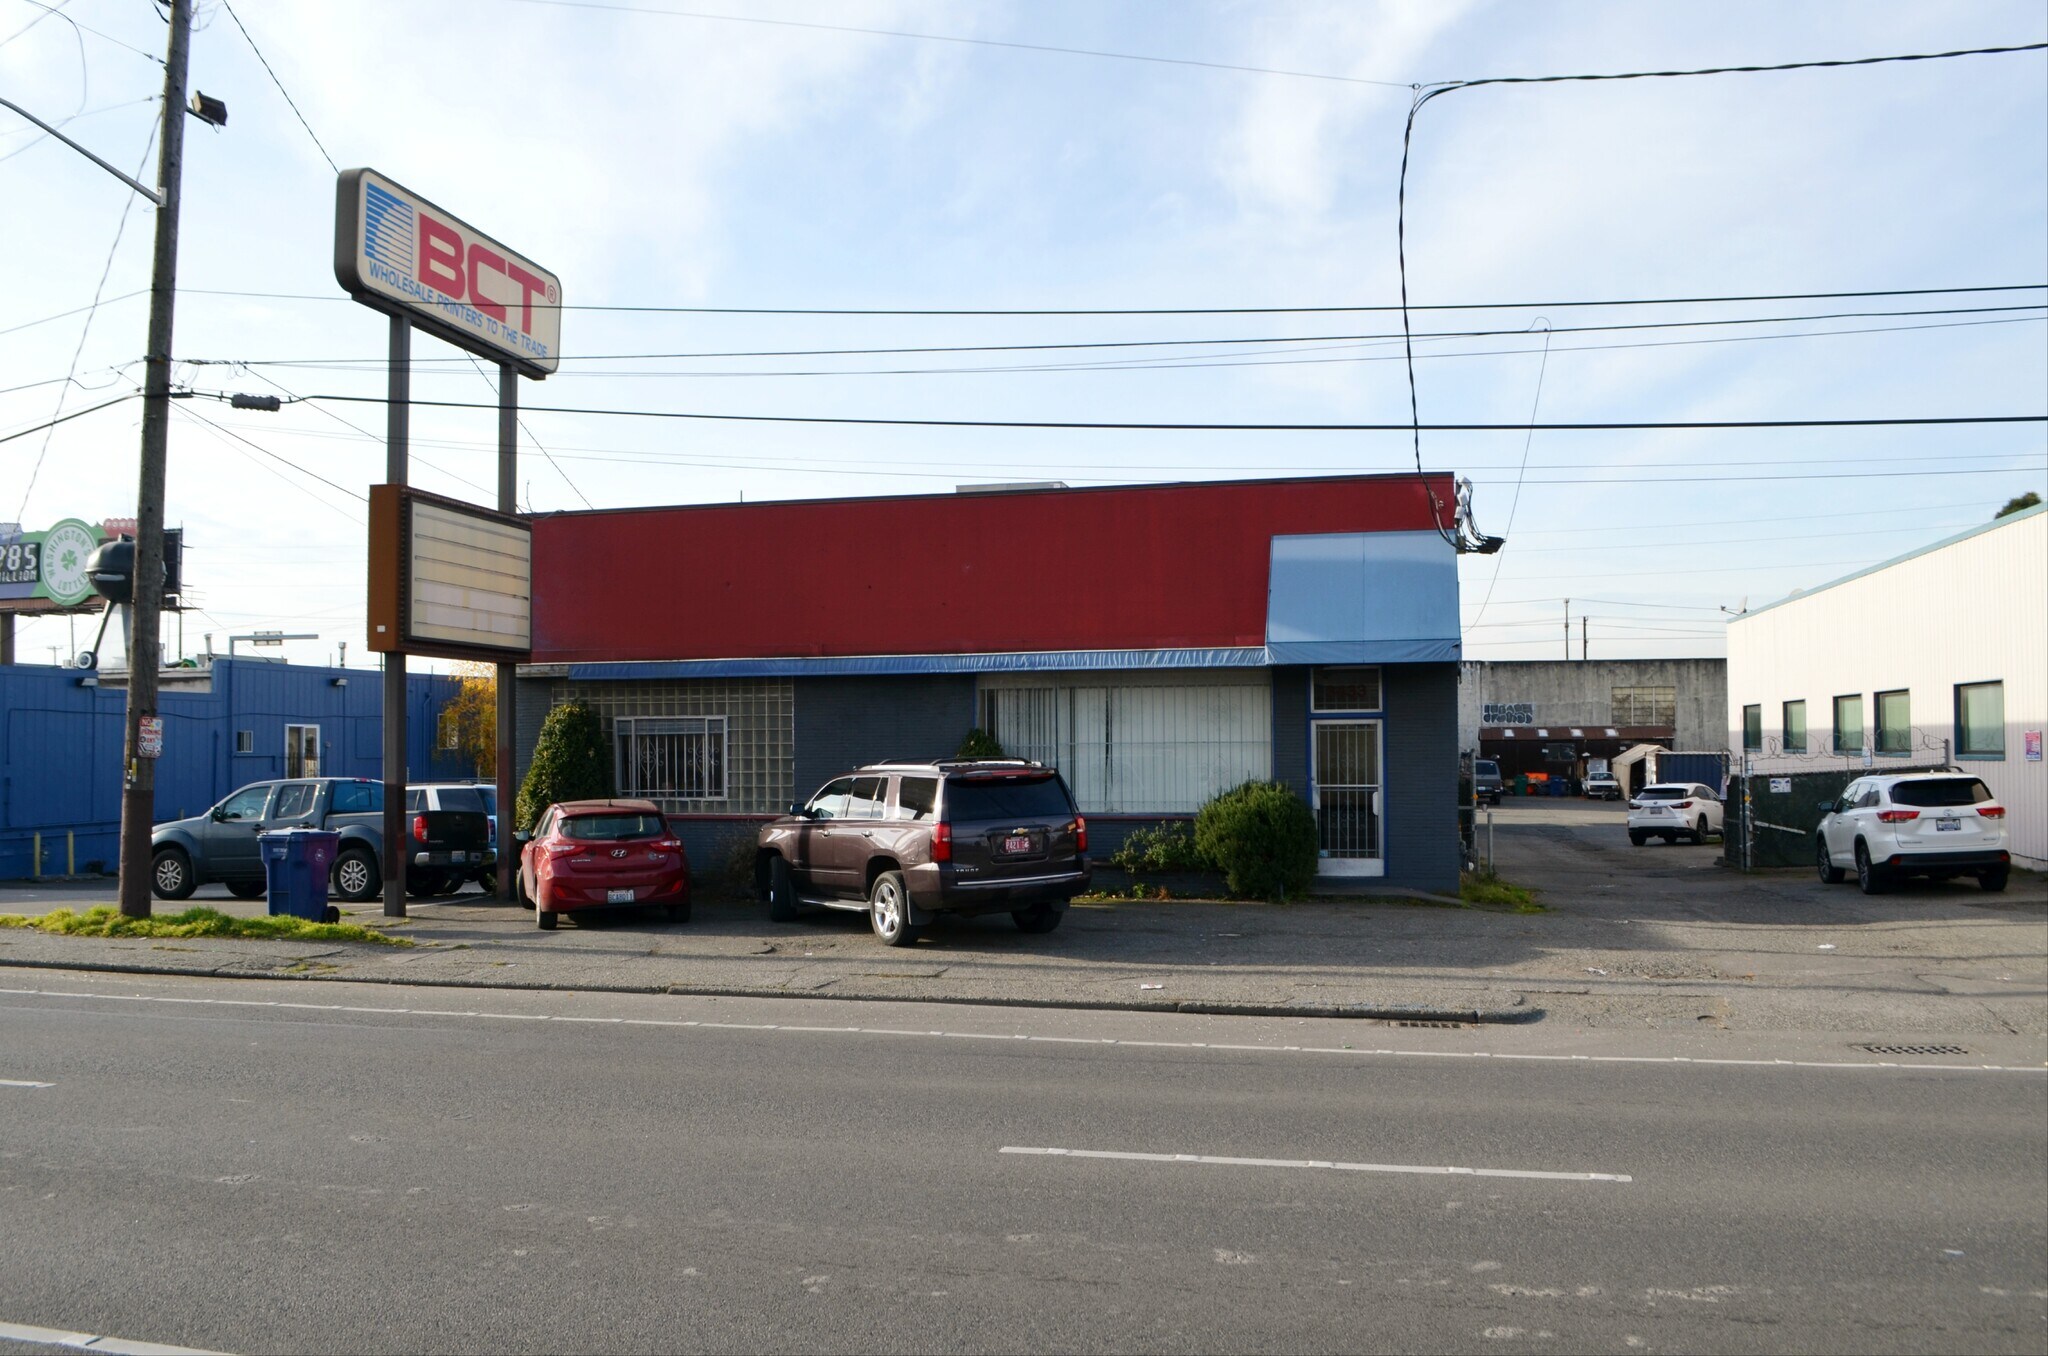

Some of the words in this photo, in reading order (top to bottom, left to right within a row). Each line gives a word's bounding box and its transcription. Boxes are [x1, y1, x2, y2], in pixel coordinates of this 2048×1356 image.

[368, 260, 434, 304] WHOLESALE
[436, 293, 483, 328] PRINTERS
[486, 317, 498, 335] TO
[501, 324, 518, 345] THE
[521, 334, 548, 358] TRADE
[418, 211, 546, 336] BCT
[0, 569, 37, 583] ILLION
